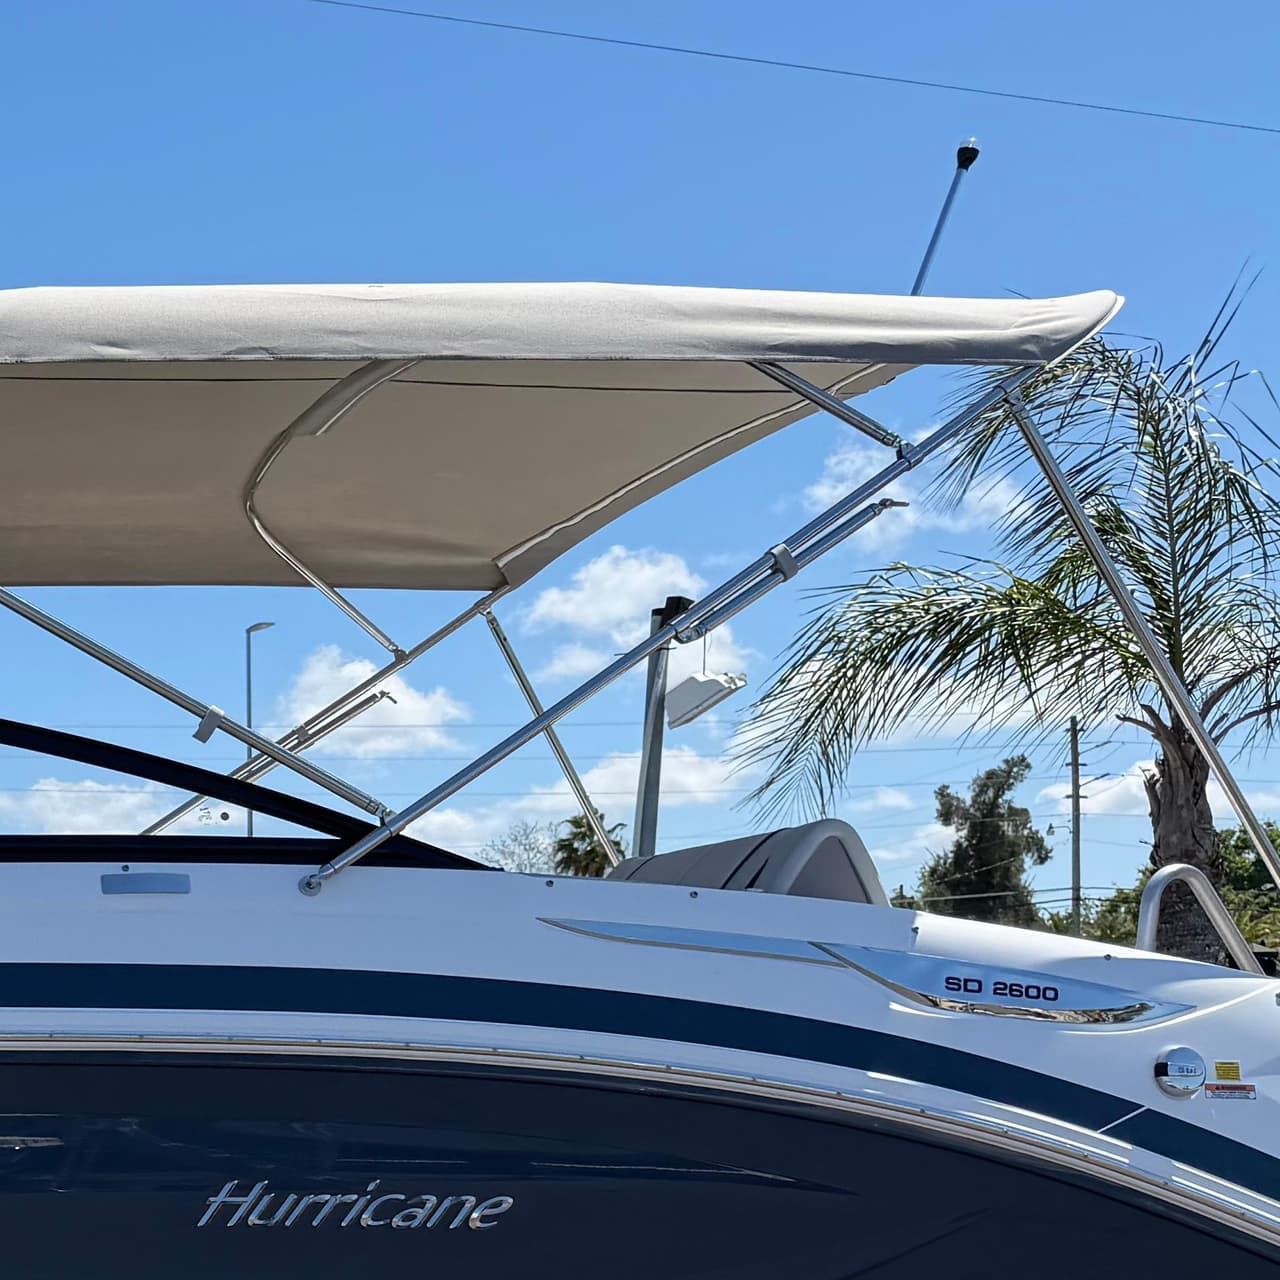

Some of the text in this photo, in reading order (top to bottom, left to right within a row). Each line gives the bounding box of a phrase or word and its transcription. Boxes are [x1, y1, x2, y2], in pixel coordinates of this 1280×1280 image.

[944, 976, 1059, 1002] SD 2600
[197, 1179, 514, 1230] Hurricane
